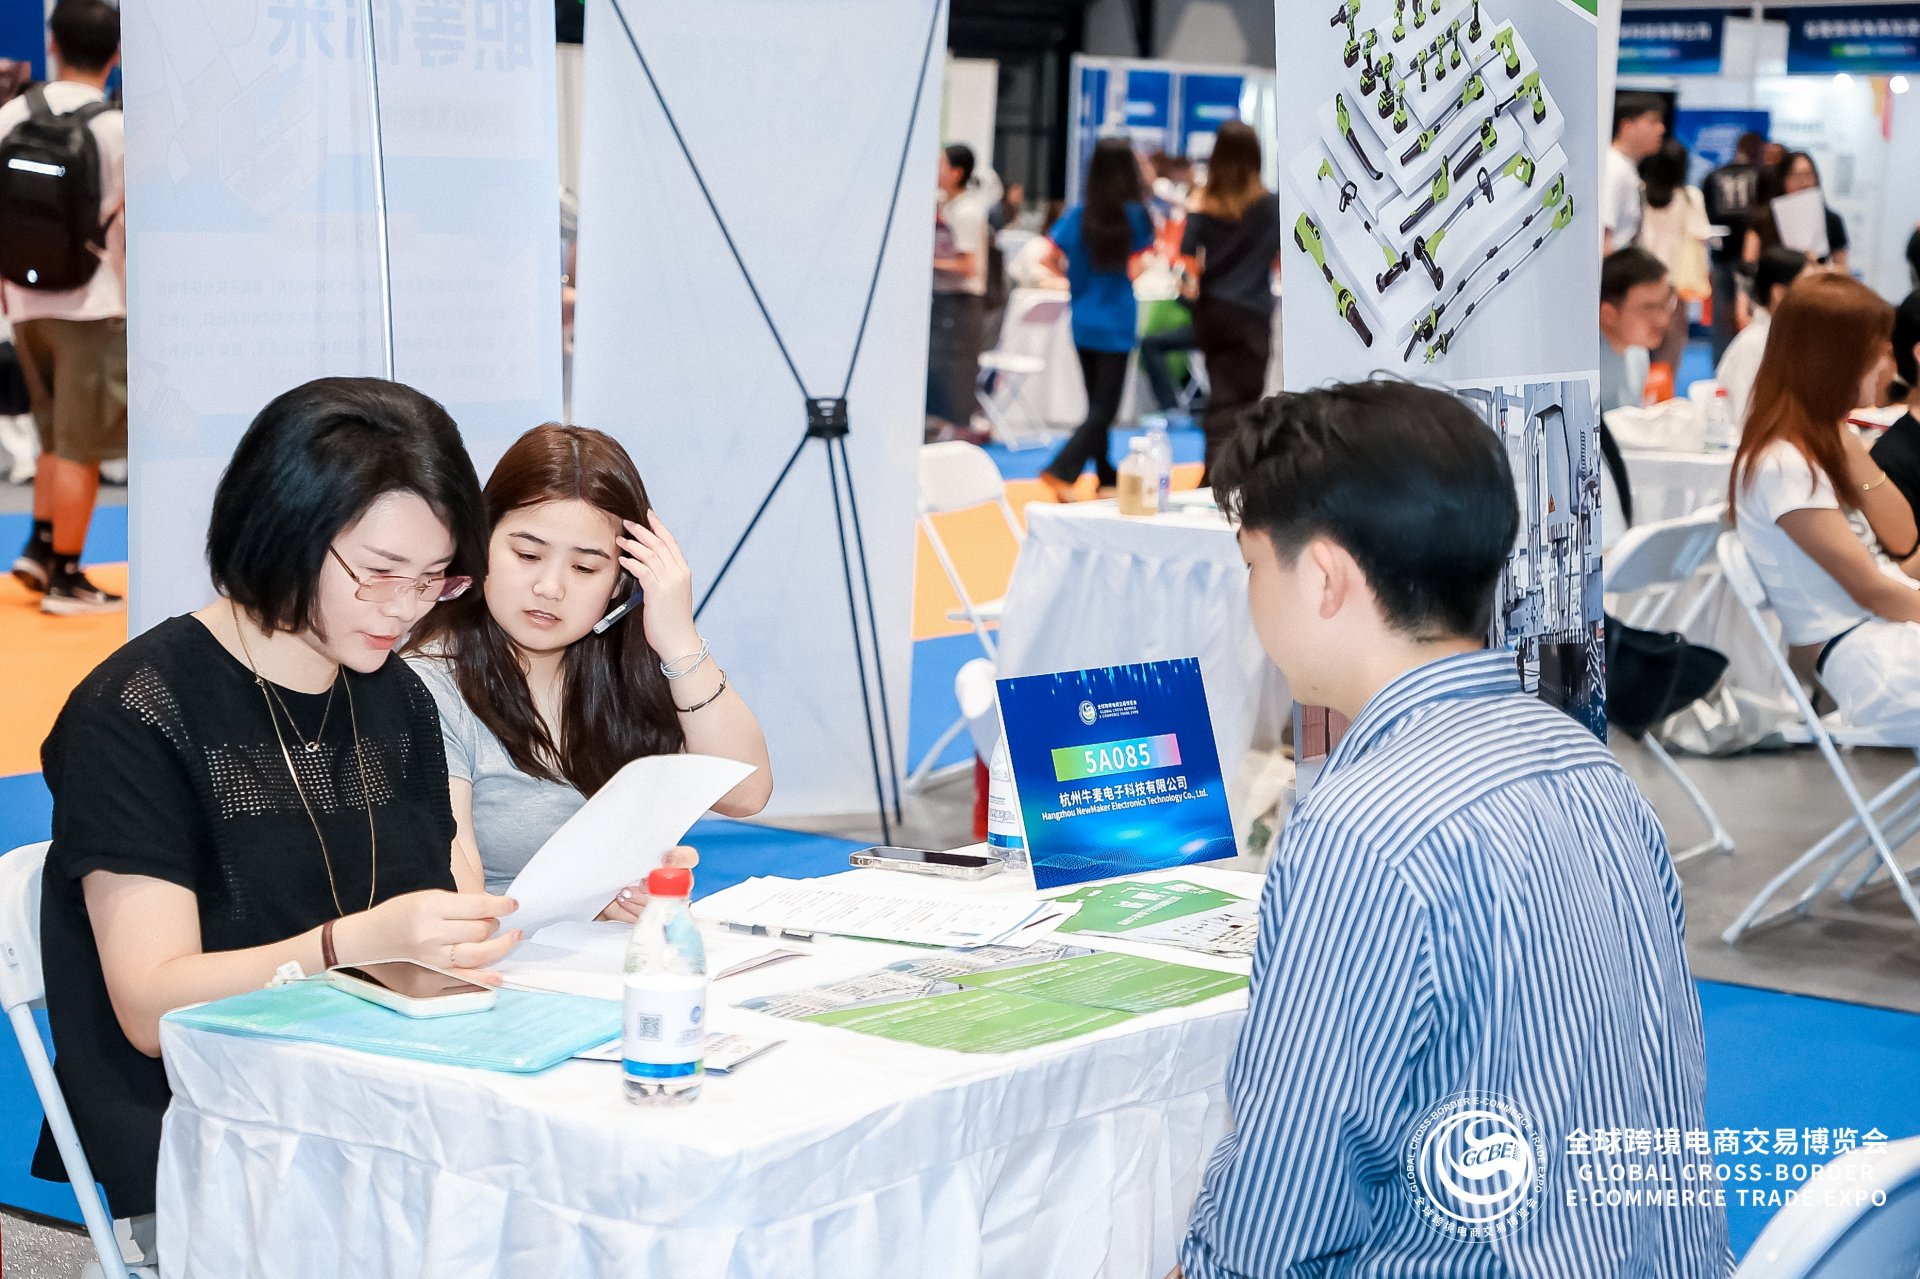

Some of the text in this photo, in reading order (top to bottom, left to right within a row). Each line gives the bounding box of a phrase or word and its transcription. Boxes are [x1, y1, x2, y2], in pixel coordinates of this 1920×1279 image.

[1084, 743, 1151, 773] 5A085
[1041, 809, 1076, 821] Hangzhou
[1076, 804, 1111, 815] NewMaker
[1111, 799, 1147, 810] Electronics
[1147, 793, 1183, 806] Technology
[1196, 788, 1209, 798] Ltd.
[1059, 775, 1188, 808] 杭州牛麦电子科技有限公司
